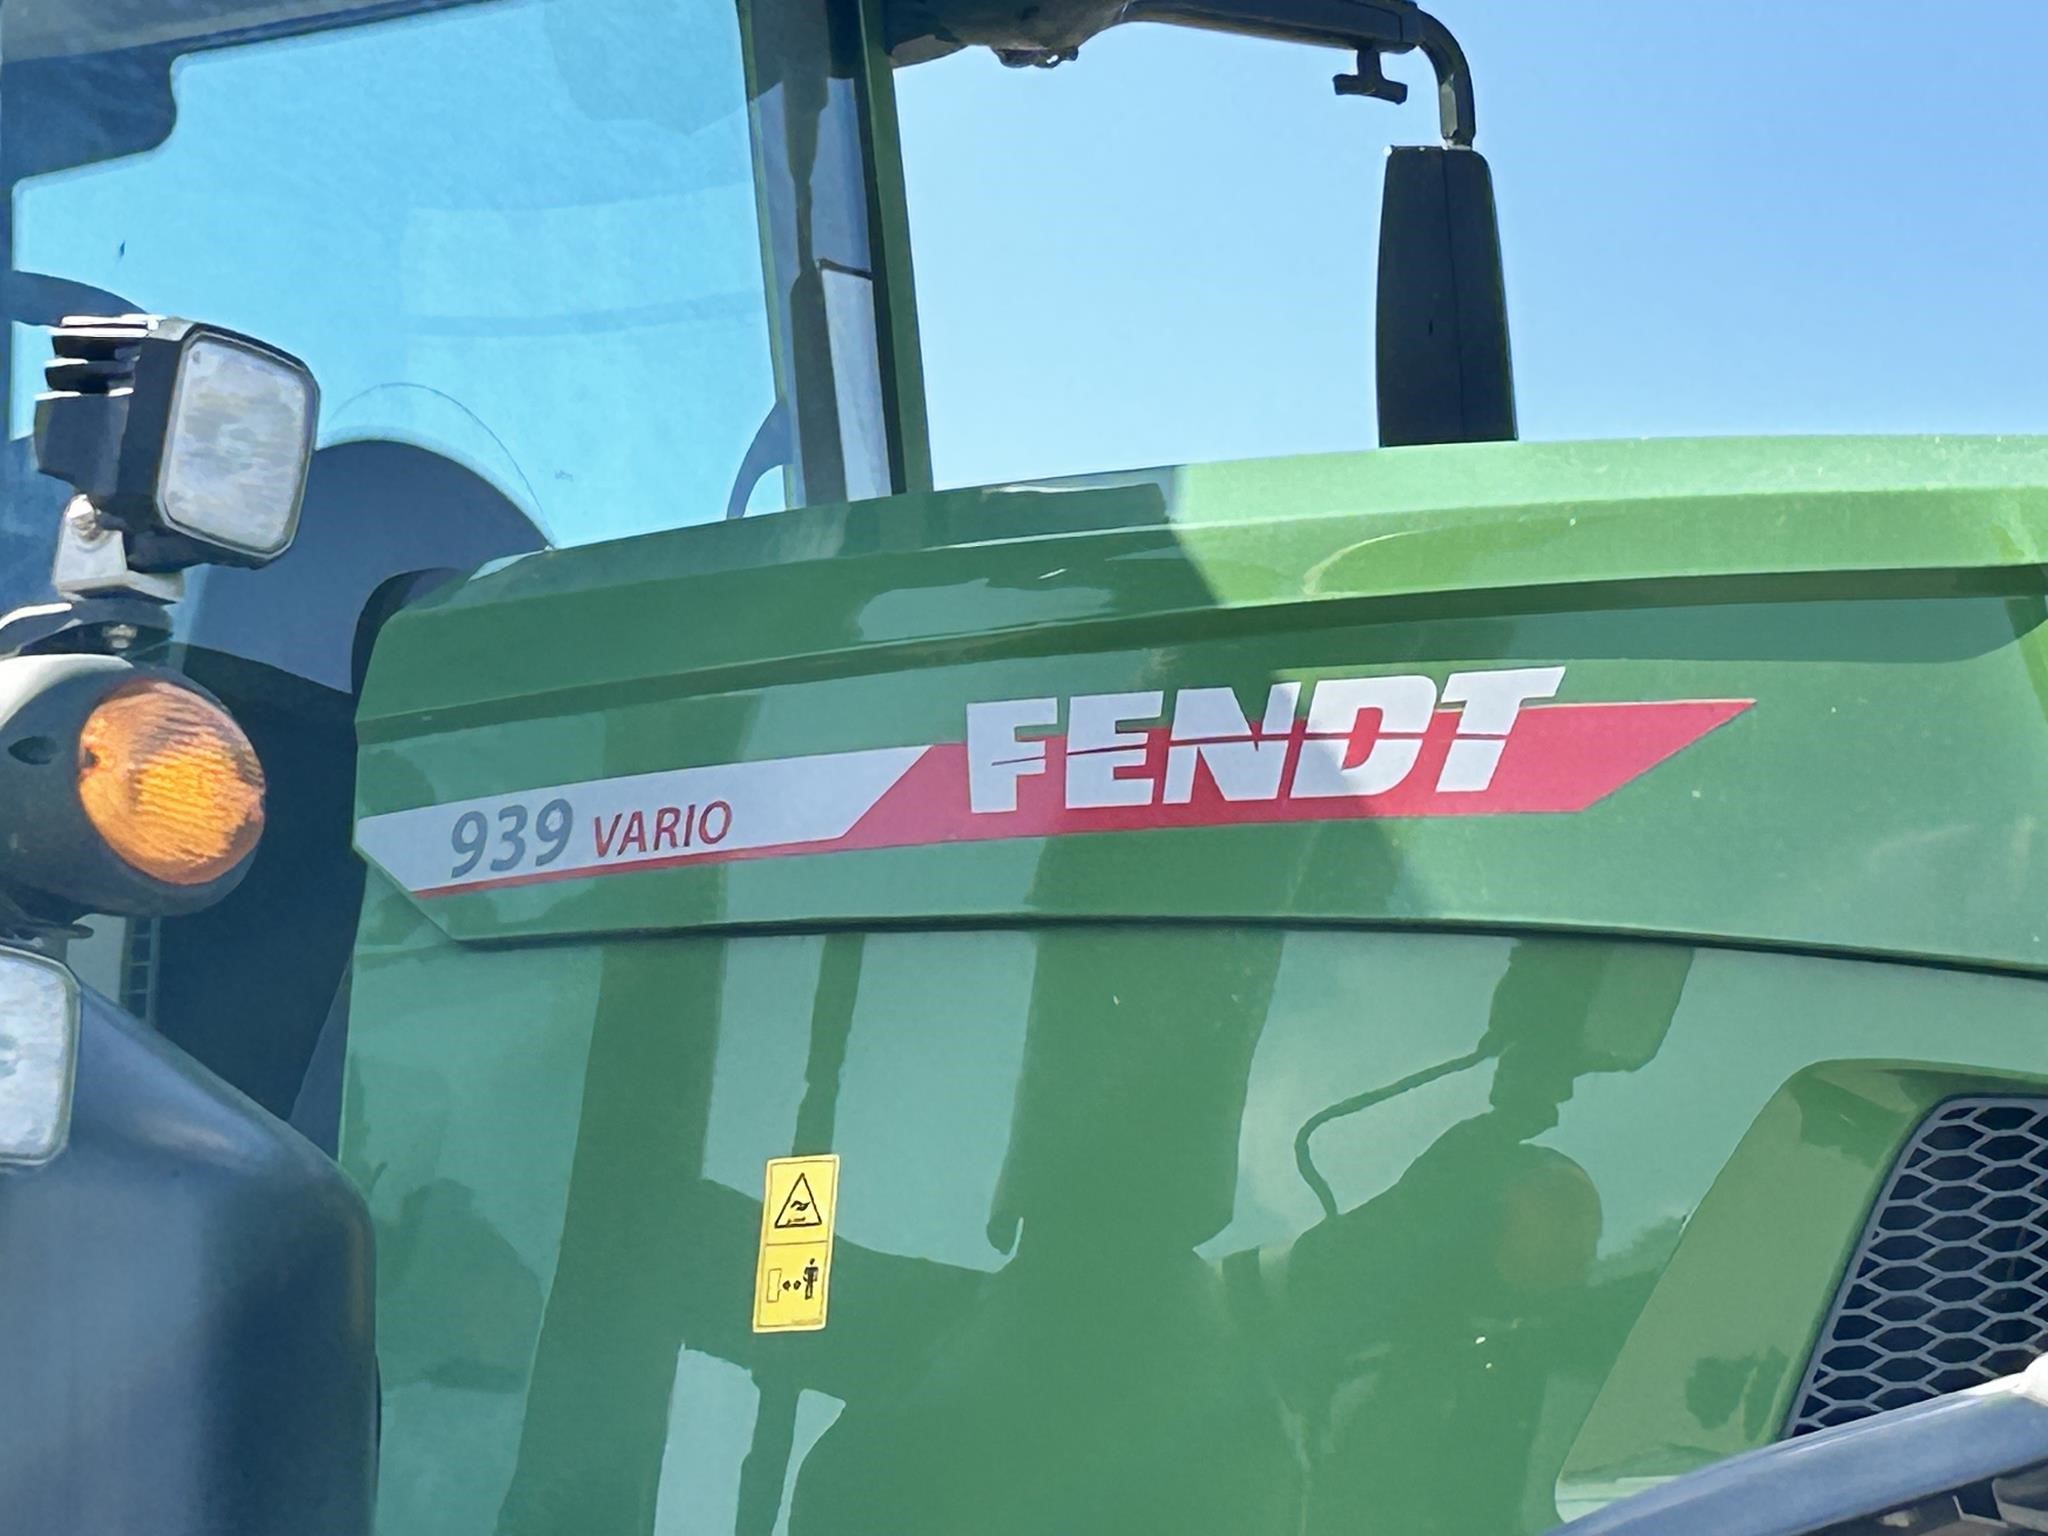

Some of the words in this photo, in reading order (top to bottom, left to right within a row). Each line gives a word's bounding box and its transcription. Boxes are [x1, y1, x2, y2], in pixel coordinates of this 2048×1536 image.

[966, 667, 1566, 814] FENDT
[451, 798, 574, 879] 939
[593, 800, 732, 858] VARIO
